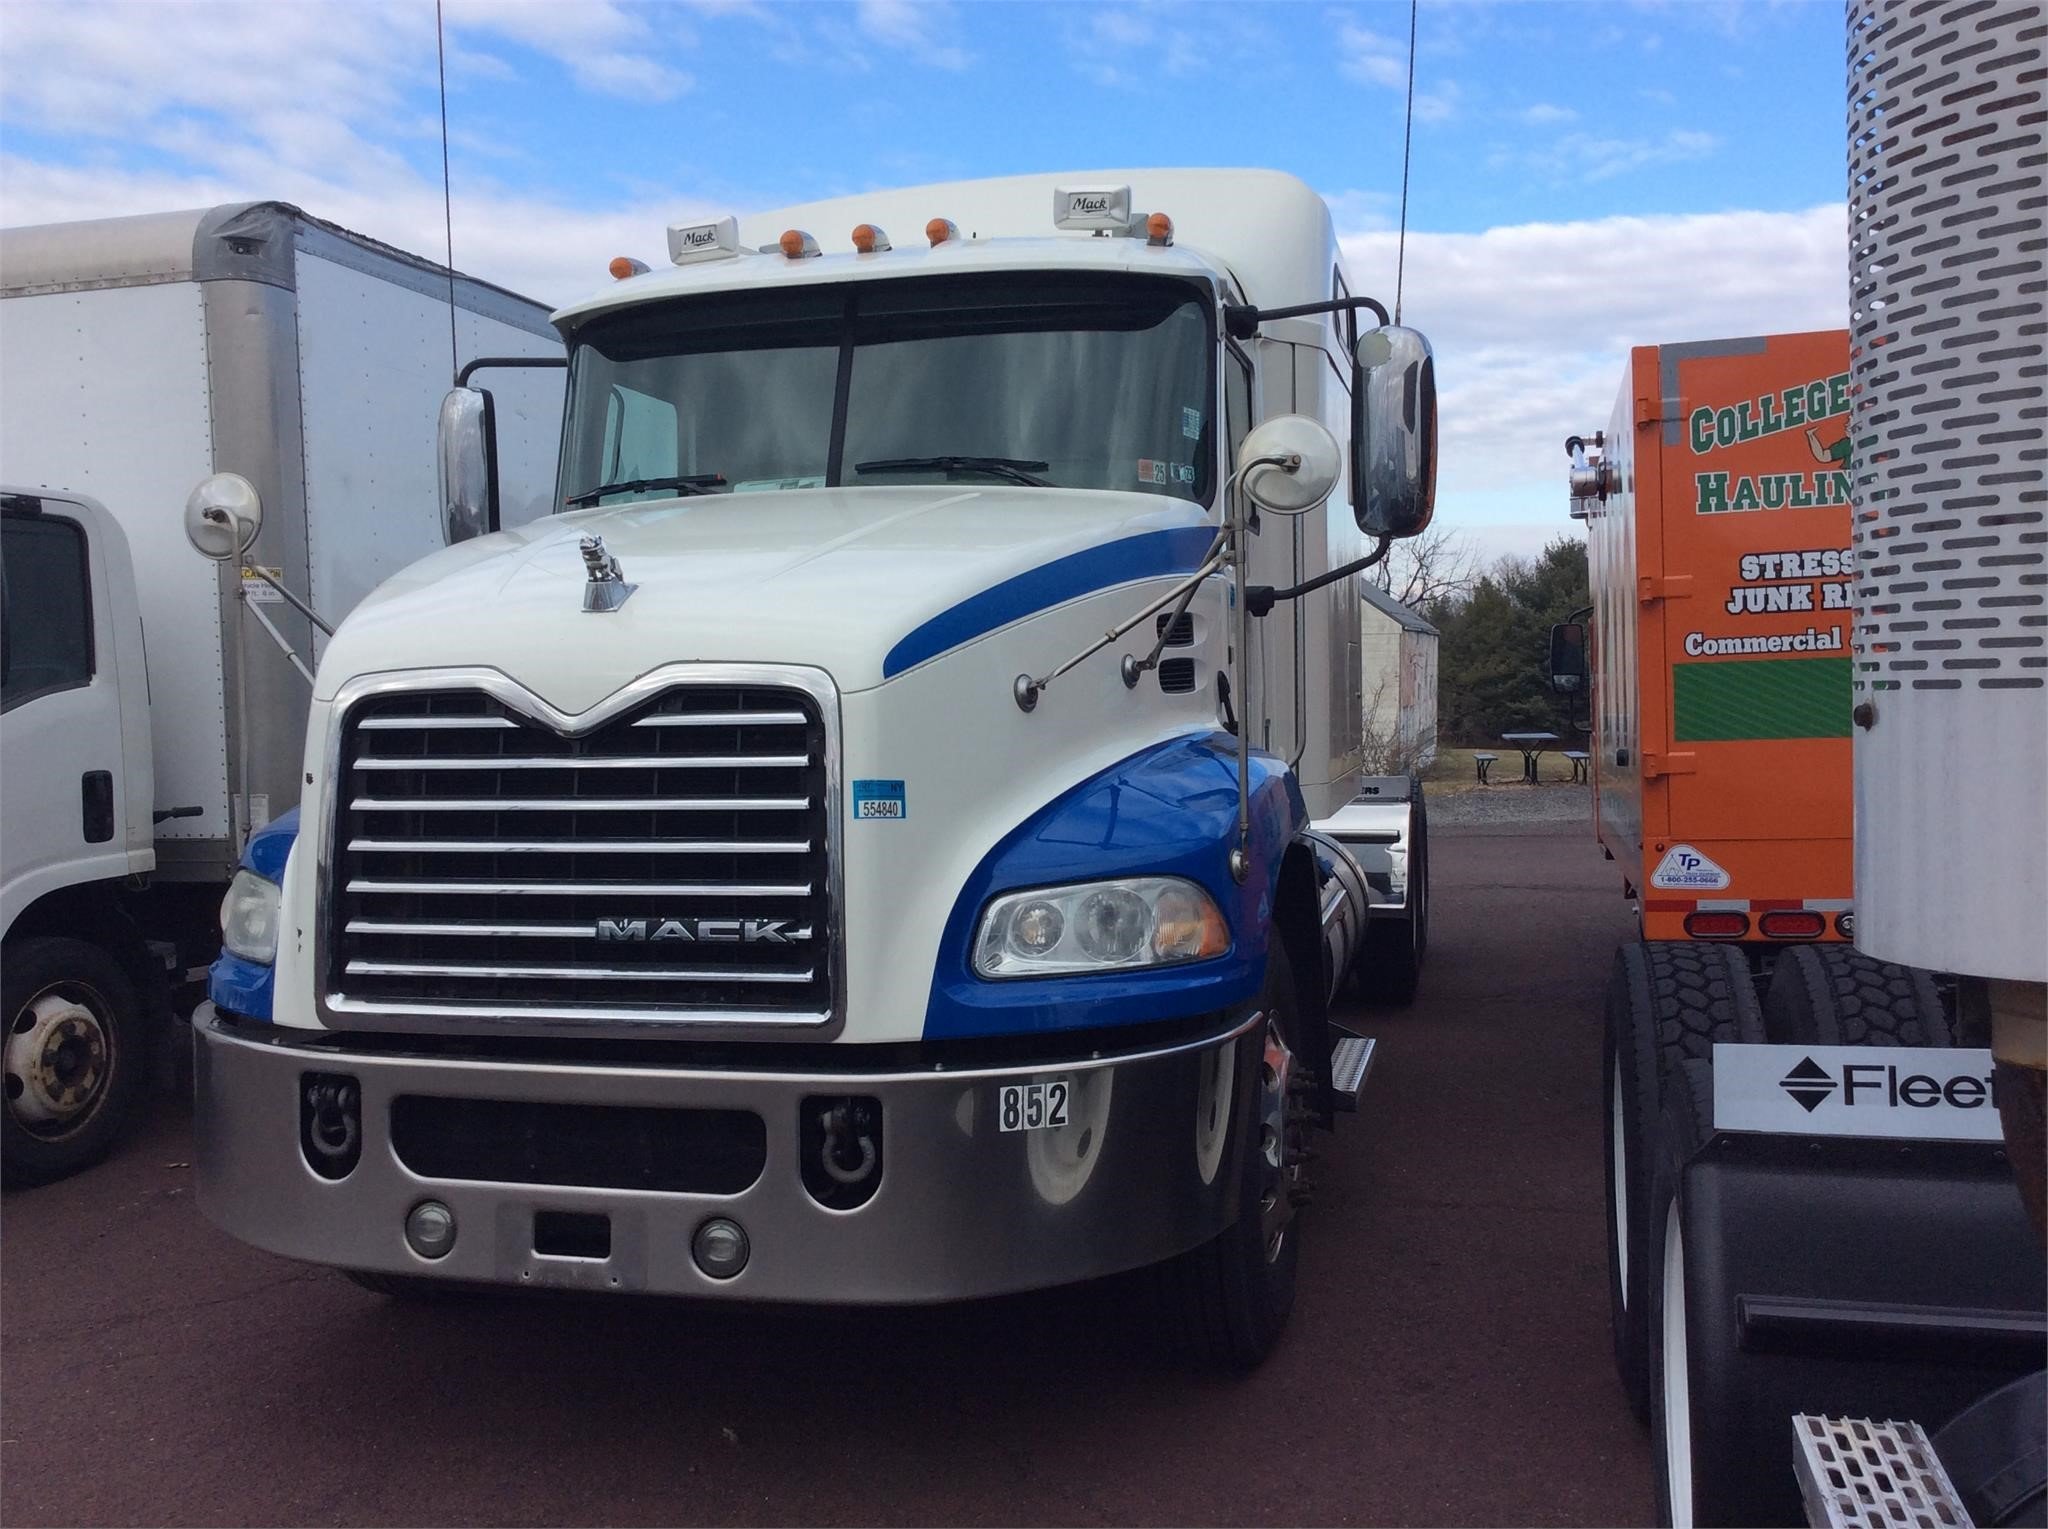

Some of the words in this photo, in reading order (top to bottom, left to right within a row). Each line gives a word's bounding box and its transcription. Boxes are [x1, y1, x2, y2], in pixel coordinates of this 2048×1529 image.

[1072, 197, 1107, 213] Mack
[683, 229, 716, 247] Mack
[1689, 371, 1852, 455] COLLEGE
[1740, 550, 1852, 580] STRESS
[1726, 584, 1812, 614] JUNK
[1685, 625, 1842, 656] Commercial
[863, 801, 898, 817] 554840
[1678, 853, 1701, 871] TP
[598, 919, 790, 942] MACK
[1003, 1083, 1067, 1130] 852
